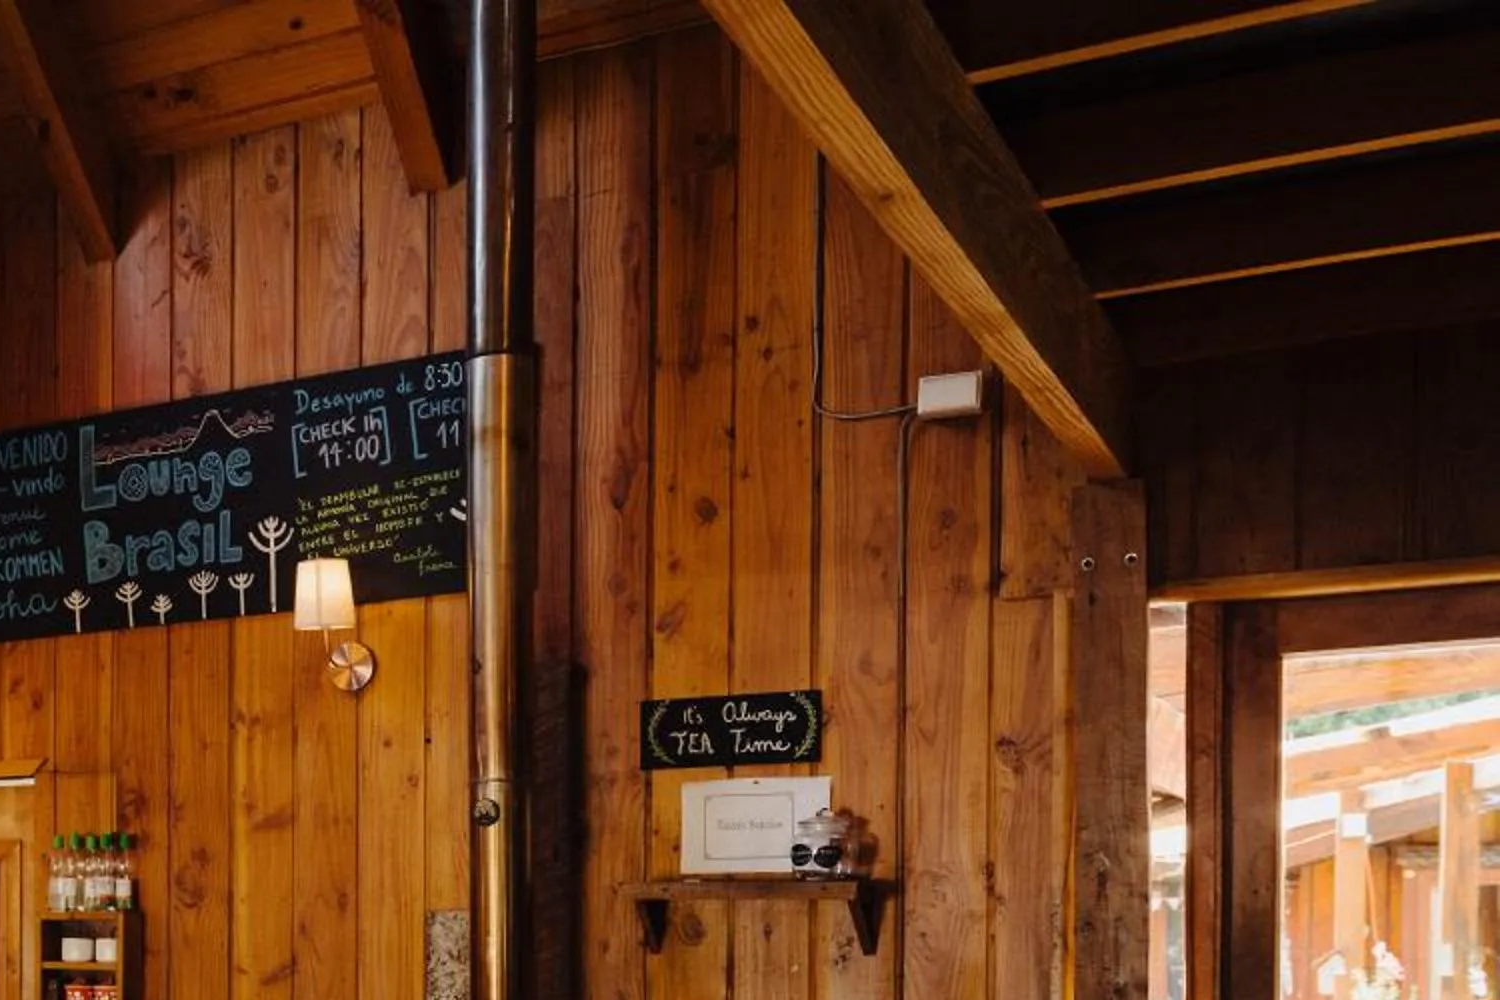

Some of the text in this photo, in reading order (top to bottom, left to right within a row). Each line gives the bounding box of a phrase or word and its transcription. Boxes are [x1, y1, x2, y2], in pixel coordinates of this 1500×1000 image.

[293, 361, 463, 416] Desayuno de 8:30
[300, 416, 356, 444] CHECK
[318, 435, 380, 469] 14:00
[79, 424, 253, 513] Lounge
[683, 701, 797, 732] It's Always
[670, 728, 791, 755] TEA Time
